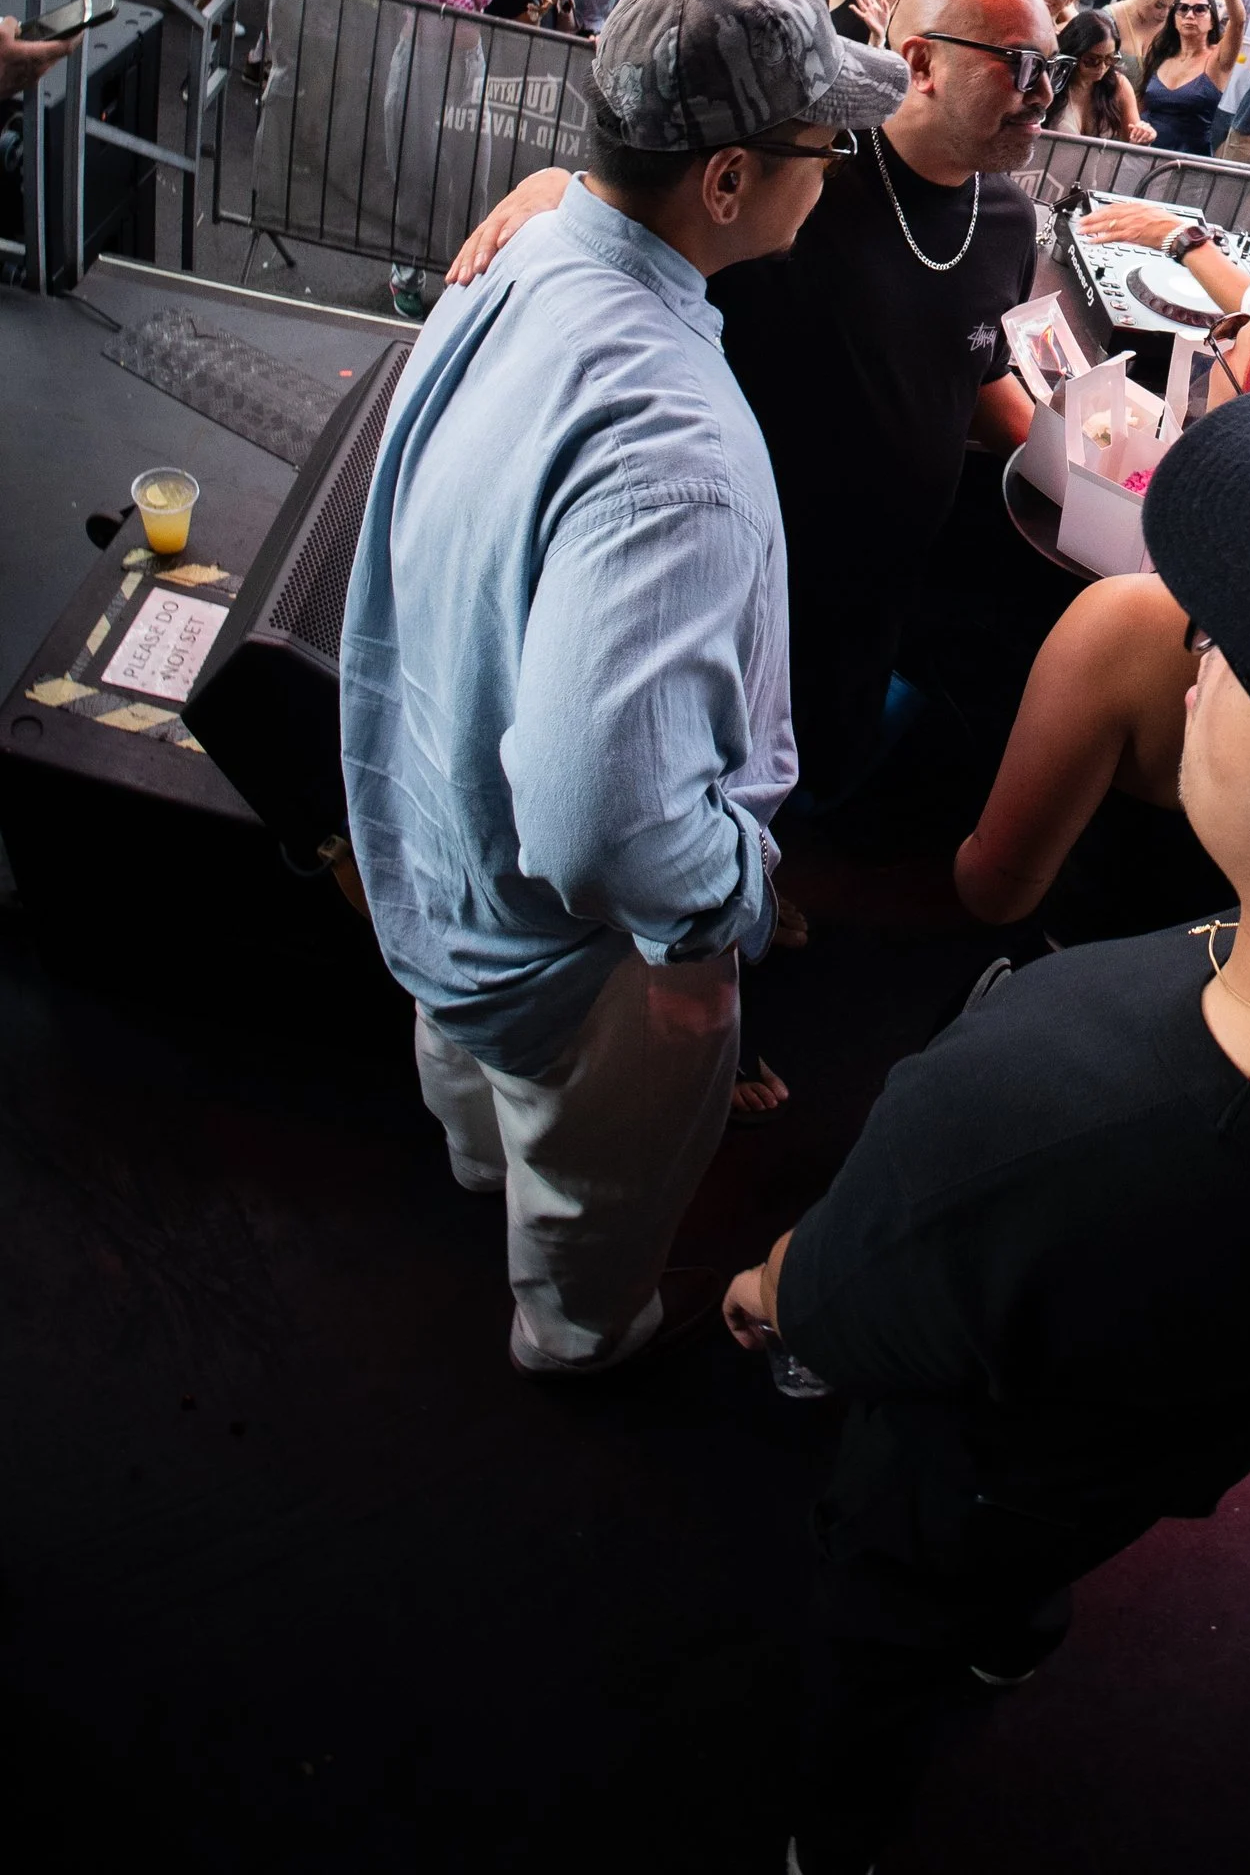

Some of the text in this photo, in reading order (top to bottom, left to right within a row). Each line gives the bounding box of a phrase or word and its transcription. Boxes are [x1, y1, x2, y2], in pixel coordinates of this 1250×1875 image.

[1068, 244, 1088, 289] Pioneer
[123, 601, 179, 680] PLEASE DO
[161, 615, 205, 681] NOT SET
